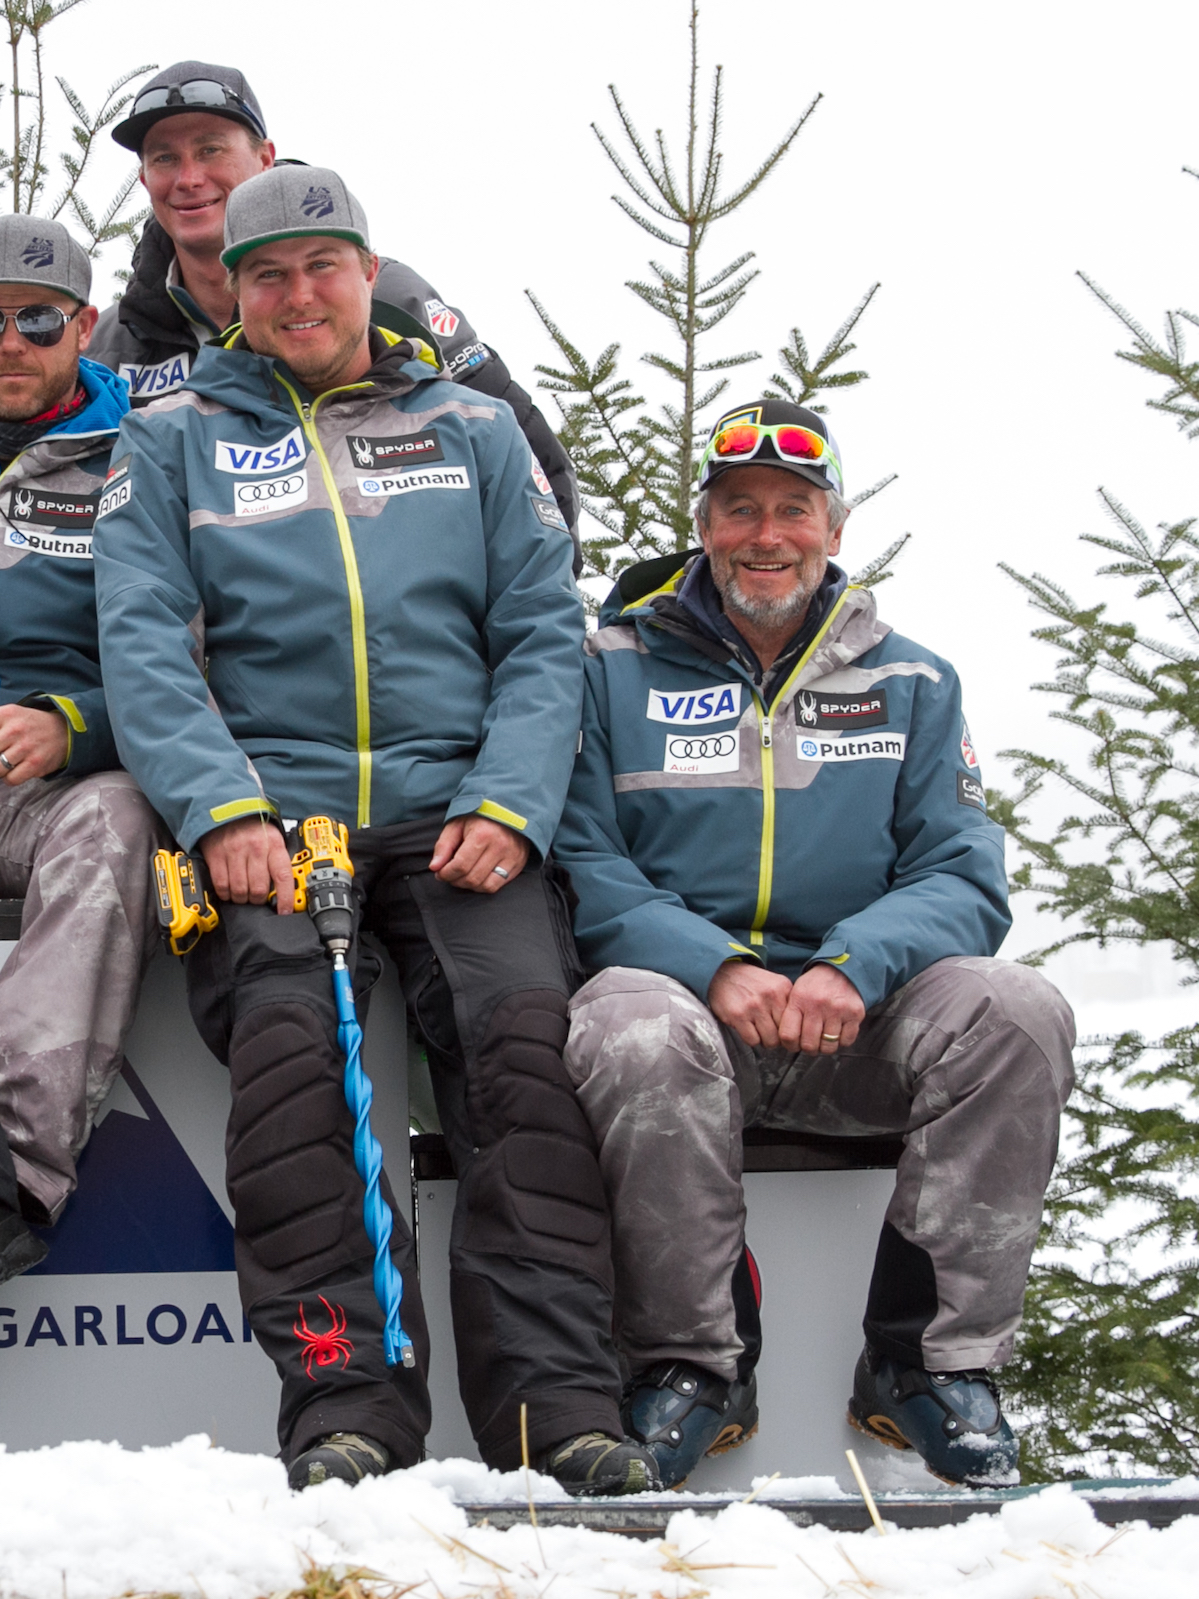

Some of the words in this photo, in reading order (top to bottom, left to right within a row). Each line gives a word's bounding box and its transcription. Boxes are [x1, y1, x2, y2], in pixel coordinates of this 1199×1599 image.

[123, 358, 186, 393] VISA
[221, 437, 301, 470] VISA
[375, 439, 436, 456] SPYDER
[382, 473, 465, 492] Putnam
[36, 500, 94, 514] SPYDER
[241, 504, 270, 515] Audi
[653, 688, 736, 720] VISA
[820, 699, 881, 714] SPYDER
[820, 740, 902, 758] Putnam
[669, 763, 700, 772] Audi
